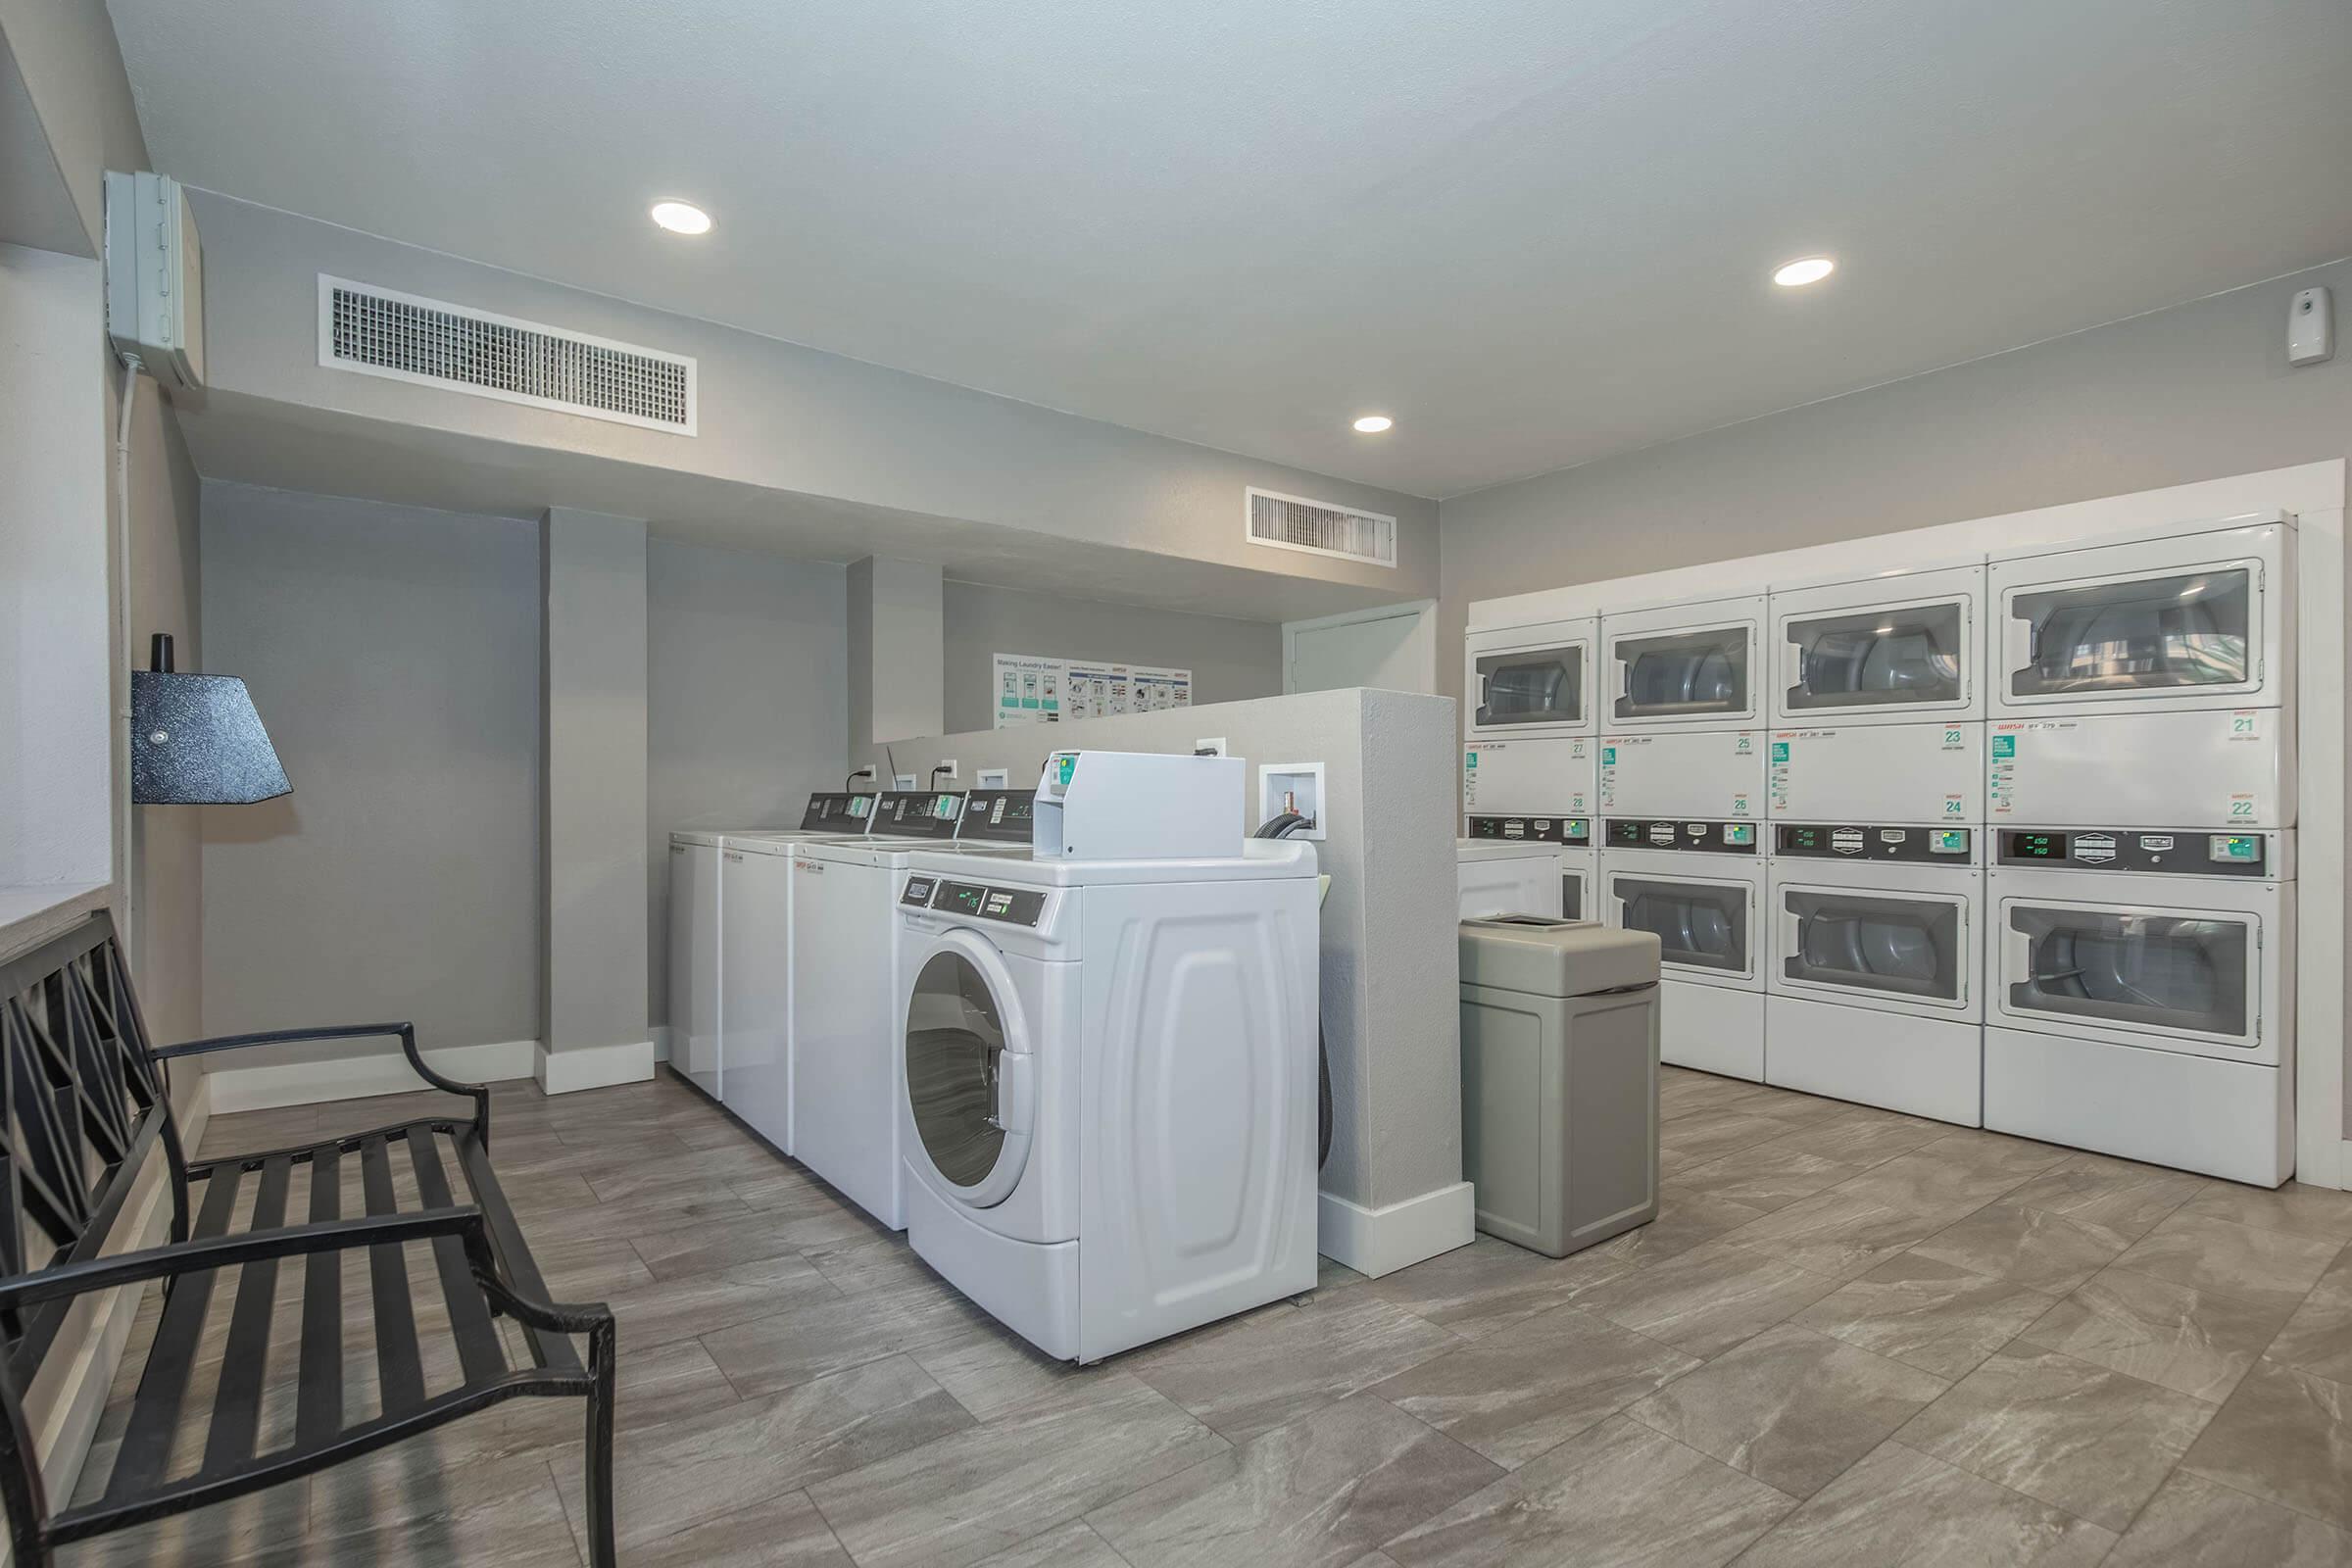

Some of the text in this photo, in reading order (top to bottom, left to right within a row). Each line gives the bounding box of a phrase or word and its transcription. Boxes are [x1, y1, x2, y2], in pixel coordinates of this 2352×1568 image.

[1019, 661, 1043, 669] Laundry
[2234, 718, 2253, 732] 21
[1945, 731, 1961, 743] 23
[1739, 738, 1750, 748] 25
[1574, 744, 1584, 753] 27
[1735, 799, 1747, 809] 26
[1946, 801, 1961, 812] 24
[2232, 802, 2252, 814] 22
